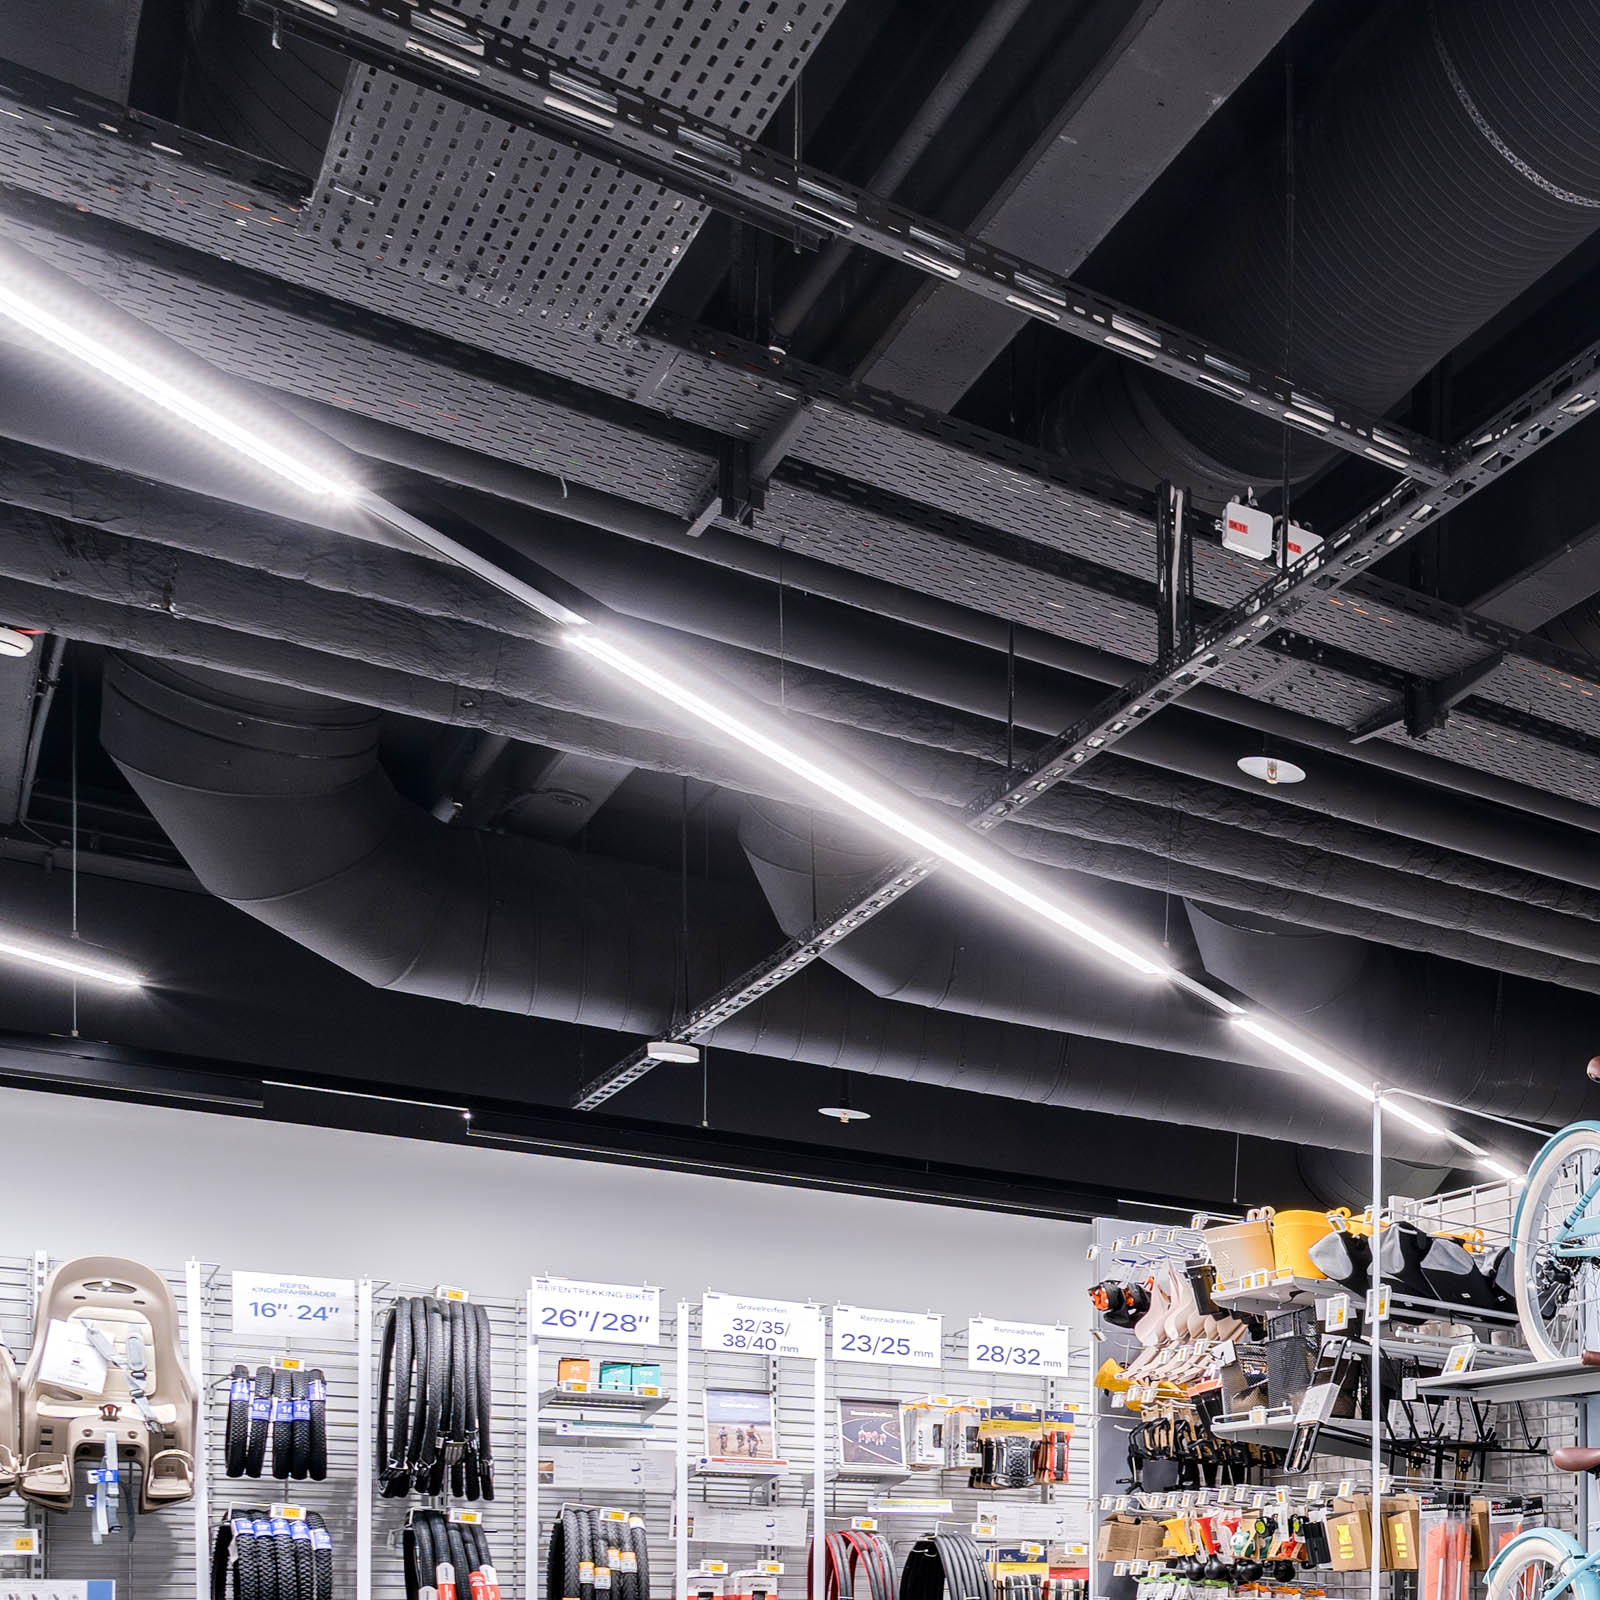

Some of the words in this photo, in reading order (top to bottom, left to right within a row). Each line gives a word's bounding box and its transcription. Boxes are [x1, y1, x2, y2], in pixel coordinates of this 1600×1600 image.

[252, 1287, 337, 1298] KINDERFAHRRÄDER
[537, 1284, 571, 1294] REIFEN
[249, 1302, 288, 1318] 16"
[297, 1305, 340, 1321] 24"
[541, 1307, 650, 1332] 26"/28"
[860, 1314, 916, 1326] Rennradreifen
[732, 1318, 791, 1337] 32/35/
[994, 1326, 1045, 1337] Rennradreifen
[722, 1333, 777, 1351] 38/40
[780, 1345, 799, 1353] mm
[840, 1333, 911, 1356] 23/25
[913, 1349, 934, 1359] mm
[976, 1344, 1041, 1366] 28/32
[1043, 1360, 1062, 1369] mm
